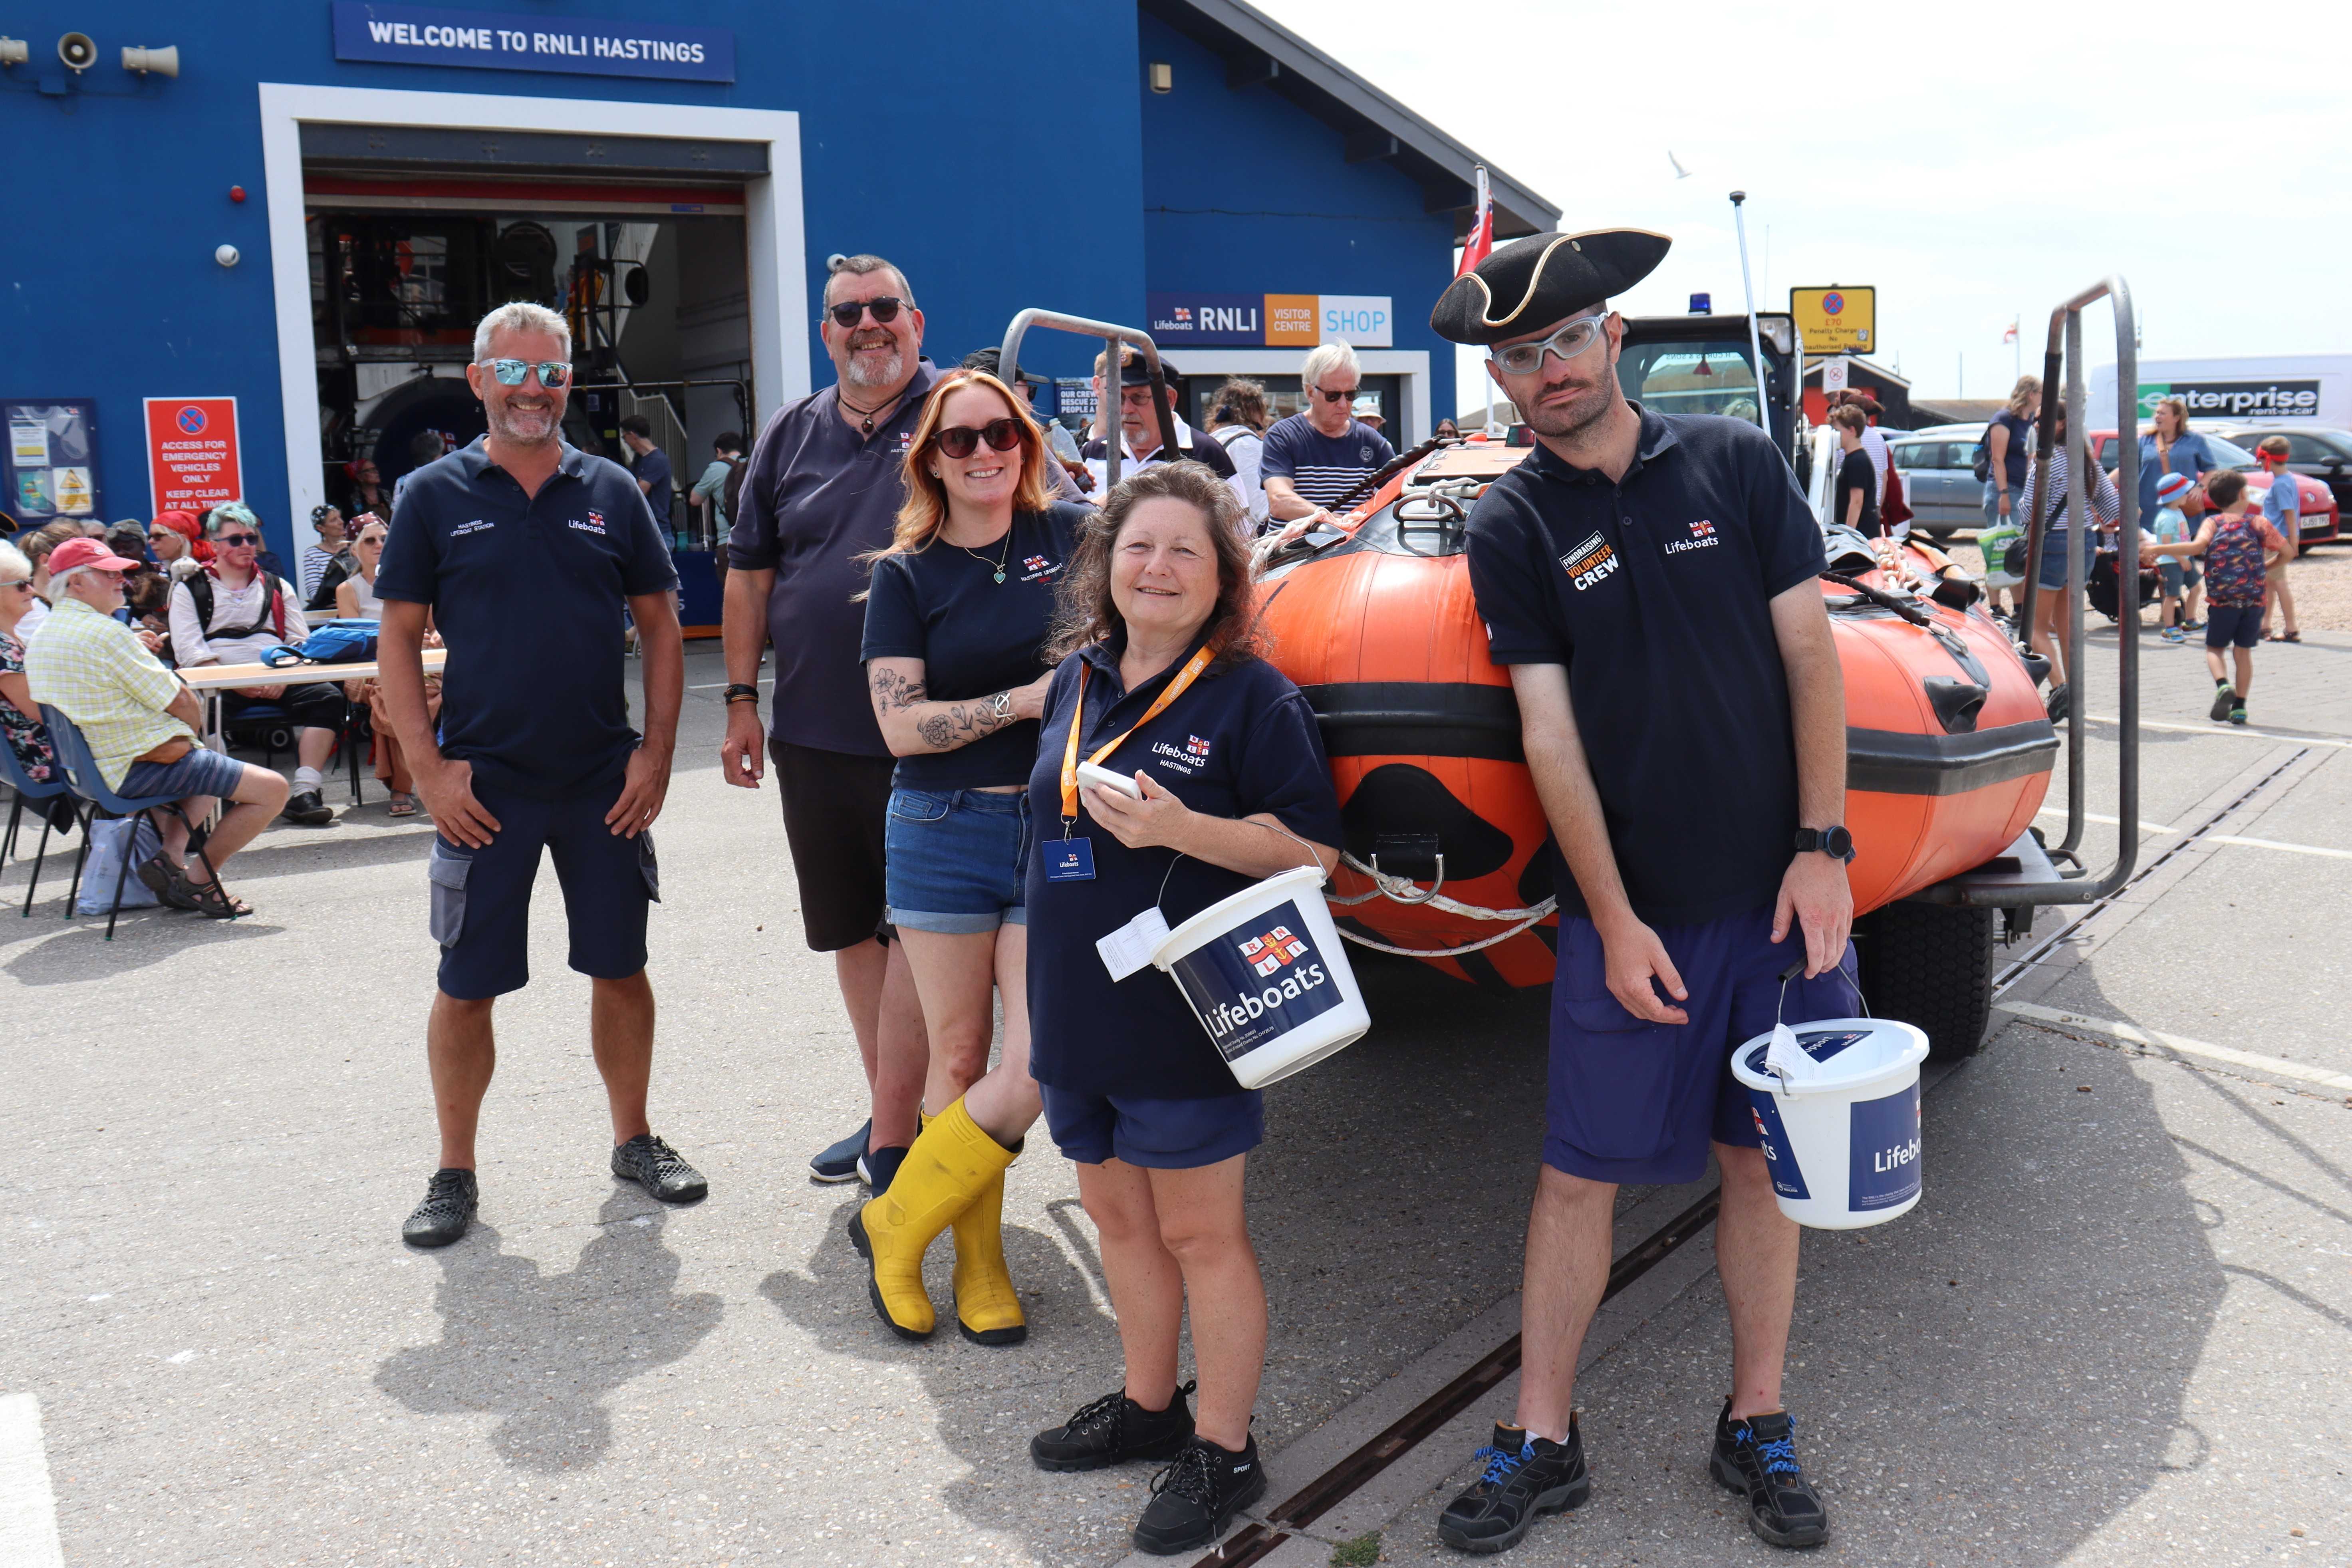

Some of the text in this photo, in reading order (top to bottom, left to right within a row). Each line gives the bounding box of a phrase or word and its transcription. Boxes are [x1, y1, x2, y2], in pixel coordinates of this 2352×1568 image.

[368, 21, 705, 64] WELCOME TO RNLI HASTINGS
[1200, 307, 1256, 331] RNLI
[1274, 308, 1311, 320] VISITOR
[1326, 310, 1385, 332] SHOP
[1155, 320, 1193, 330] Lifeboats
[1274, 321, 1311, 332] CENTRE
[2249, 407, 2315, 415] rent-a-car
[161, 441, 203, 450] ACCESS
[162, 452, 227, 461] EMERGENCY
[171, 463, 221, 472] VEHICLES
[182, 474, 211, 483] ONLY
[166, 488, 229, 498] KEEP CLEAR
[180, 501, 200, 509] ALL
[450, 522, 494, 536] LIFEBOAT STATION
[458, 520, 482, 529] HASTINGS
[568, 519, 605, 534] Lifeboats
[1562, 534, 1602, 568] FUNDRAISING
[1665, 536, 1719, 555] Lifeboats
[1567, 544, 1613, 578] VOLUNTEER
[1020, 562, 1063, 582] HASTINGS LIFEBOAT
[1574, 553, 1619, 591] CREW
[1193, 659, 1204, 674] CREW
[1168, 672, 1188, 701] FUNDRAISING
[1151, 742, 1205, 767] Lifeboats
[1160, 759, 1192, 774] HASTINGS
[1205, 963, 1325, 1038] Lifeboats
[1806, 1036, 1834, 1053] upport
[1233, 1463, 1250, 1473] SPORT
